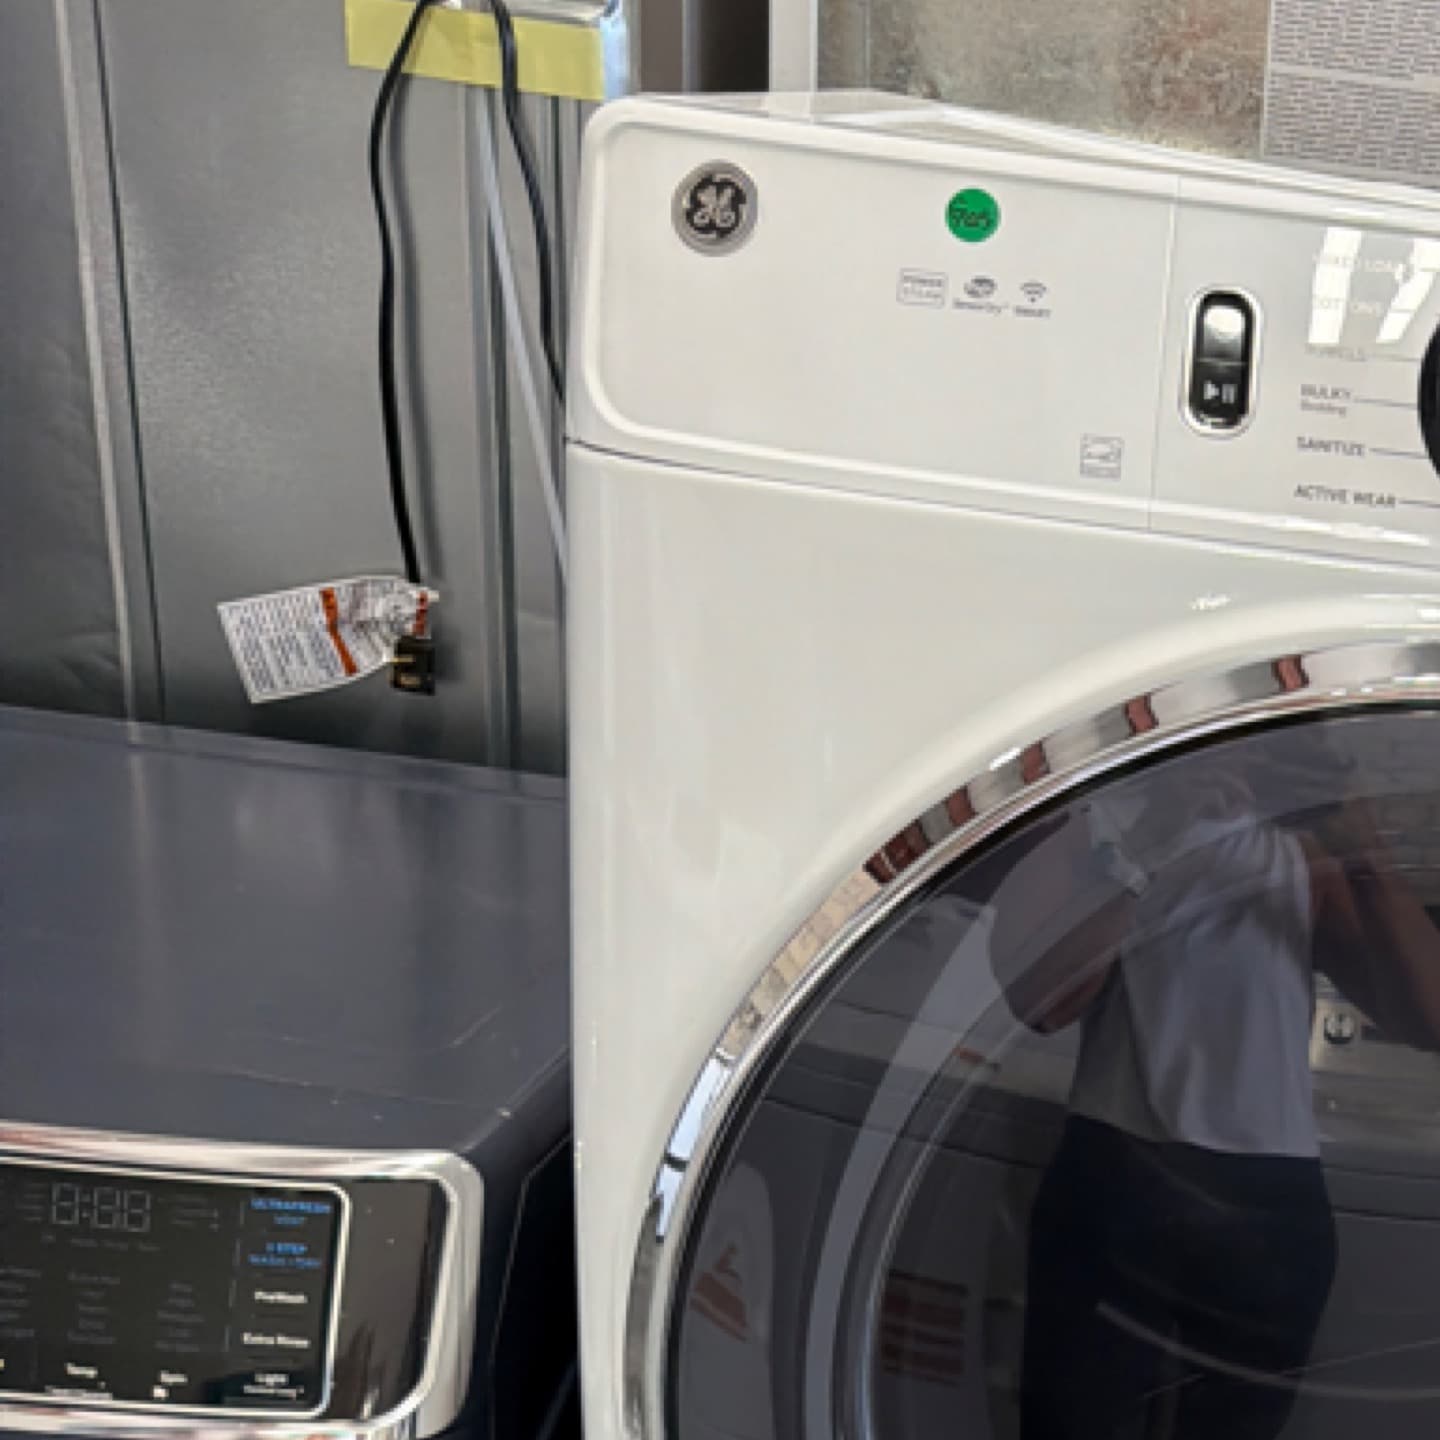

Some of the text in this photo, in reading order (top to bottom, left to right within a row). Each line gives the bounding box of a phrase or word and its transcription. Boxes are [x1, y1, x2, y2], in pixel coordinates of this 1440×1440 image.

[1297, 436, 1366, 457] SANITIZE
[1294, 485, 1396, 508] ACTIVE WEAR
